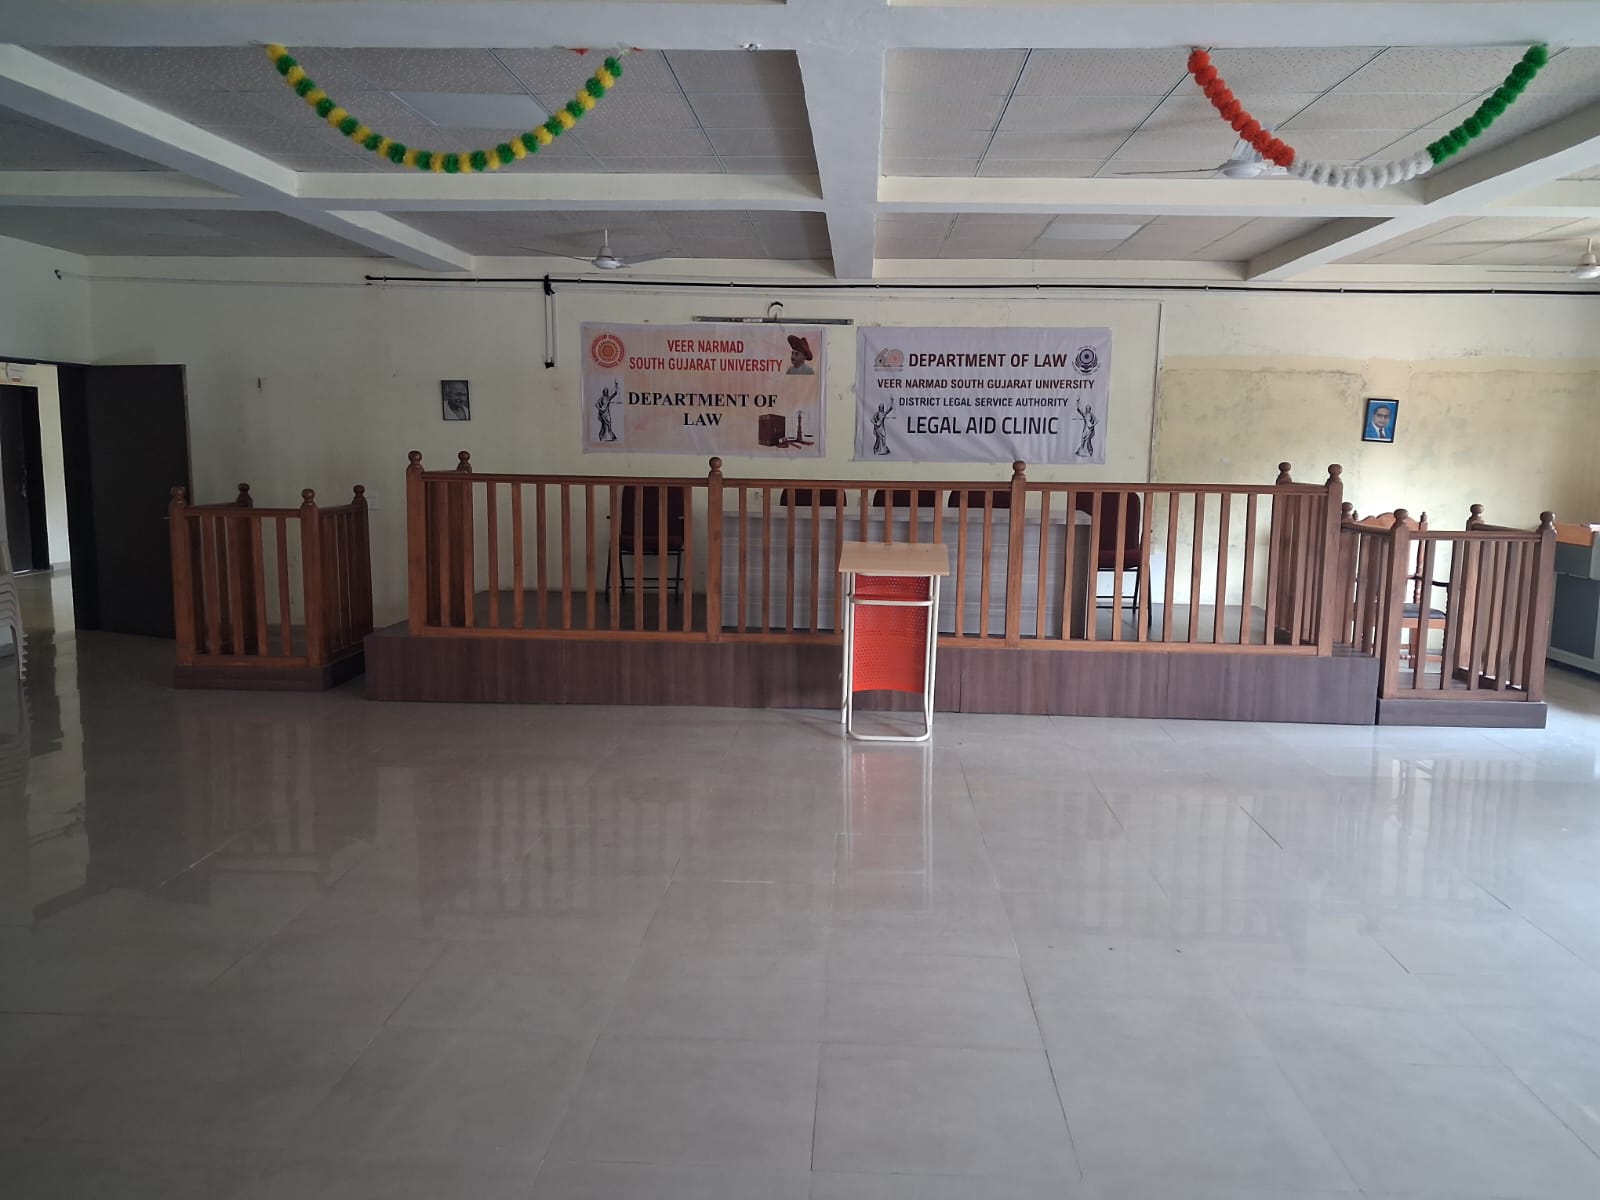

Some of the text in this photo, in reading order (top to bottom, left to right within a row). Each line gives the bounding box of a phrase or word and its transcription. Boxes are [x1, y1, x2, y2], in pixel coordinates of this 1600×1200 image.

[667, 339, 744, 353] VEER NARMAD
[629, 357, 783, 372] SOUTH GUJARAT UNIVERSITY
[908, 353, 1006, 367] DEPARTMENT
[1010, 353, 1029, 367] OF
[1033, 354, 1067, 367] LAW
[877, 378, 1095, 389] VEER NARMAD SOUTH GUJARAT UNIVERSITY
[628, 392, 778, 407] DEPARTMENT OF
[899, 397, 1069, 407] DISTRICT LEGAL SERVICE AUTHORITY
[683, 413, 723, 426] LAW
[907, 416, 1058, 434] LEGAL AID CLINIC
